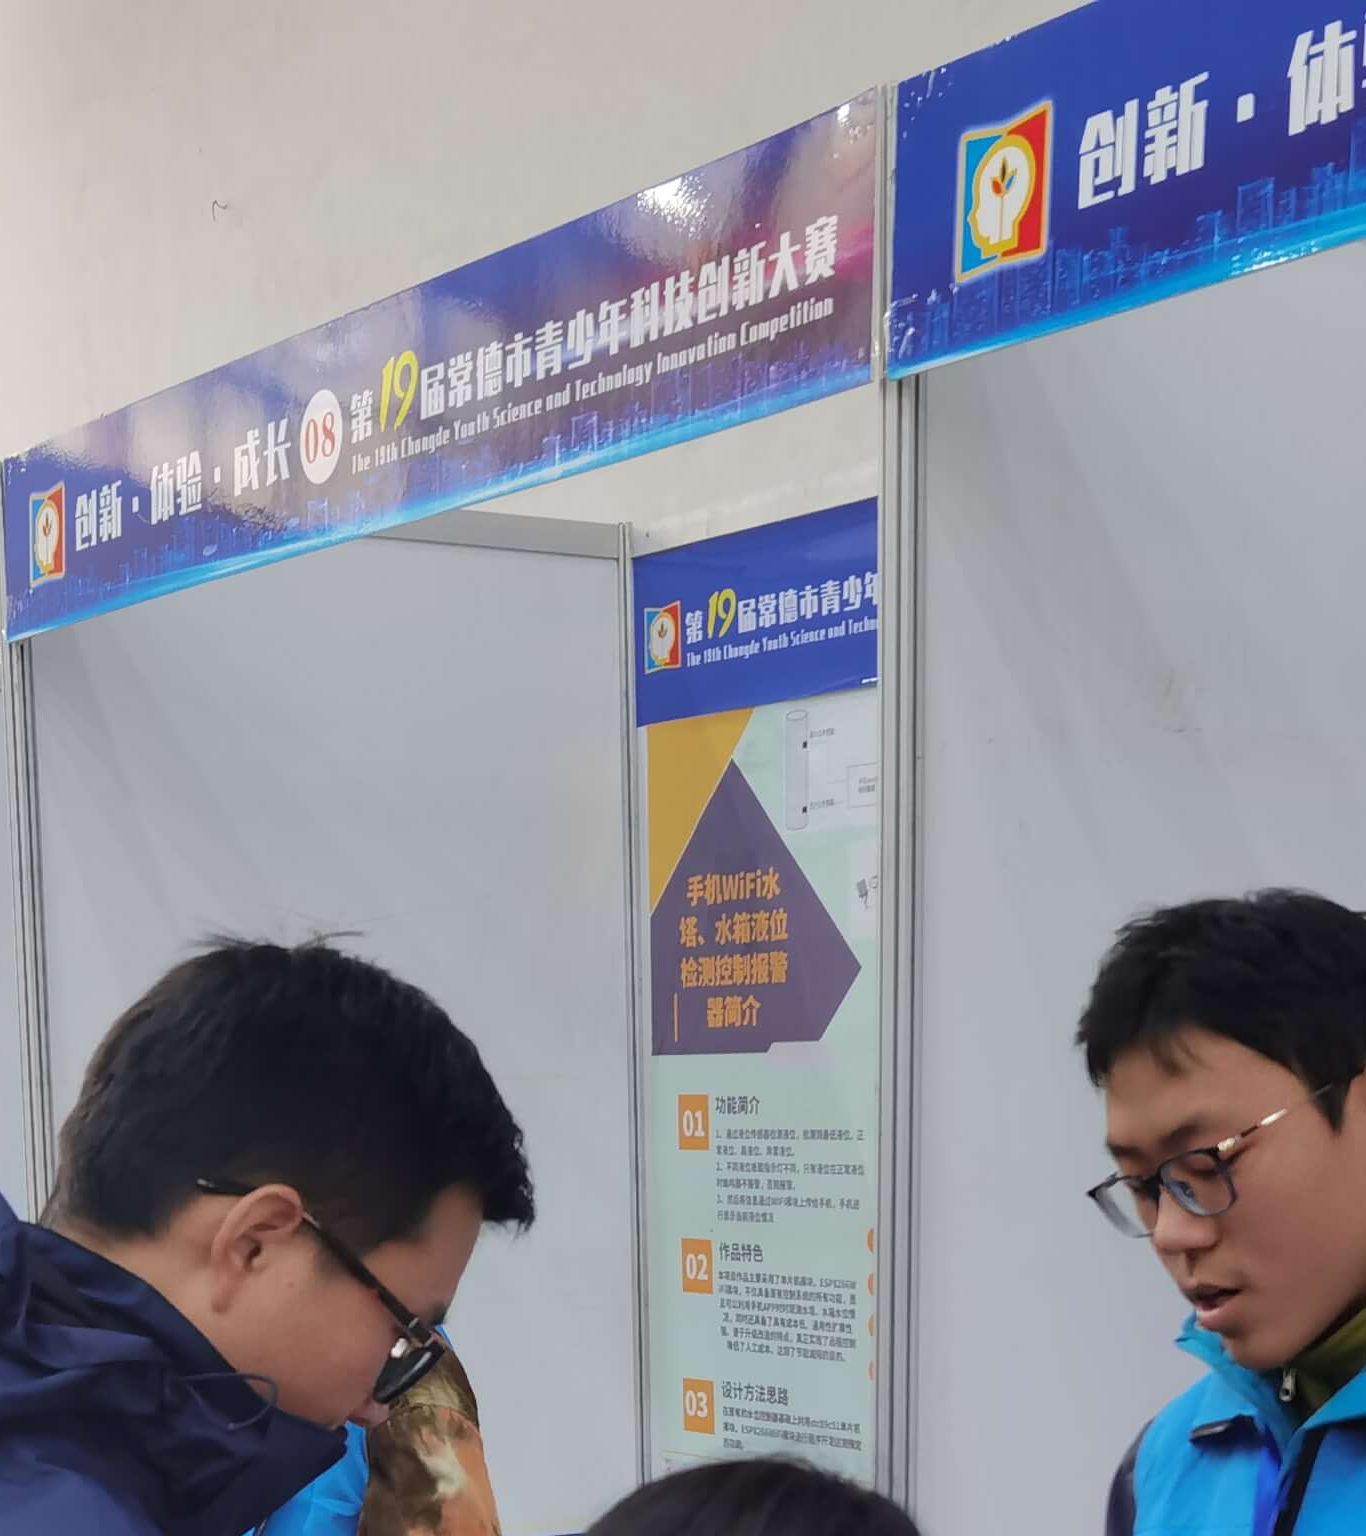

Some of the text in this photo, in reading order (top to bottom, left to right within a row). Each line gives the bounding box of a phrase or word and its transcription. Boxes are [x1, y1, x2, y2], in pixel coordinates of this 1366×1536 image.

[350, 214, 839, 444] 第19届常德市青少年科技创新大赛
[351, 297, 834, 475] The 19th Changde Youth Science and Technology Innovation Competition
[304, 411, 336, 465] 08
[687, 866, 781, 906] 手机WiFi水
[679, 907, 789, 948] 塔、水箱液位
[680, 951, 788, 988] 检测控制报警
[707, 995, 761, 1028] 器简介
[715, 1096, 761, 1115] 功能简介
[682, 1109, 705, 1137] 01
[686, 1253, 708, 1281] 02
[718, 1243, 764, 1264] 作品特色
[685, 1390, 708, 1418] 03
[721, 1381, 789, 1407] 设计方法思路
